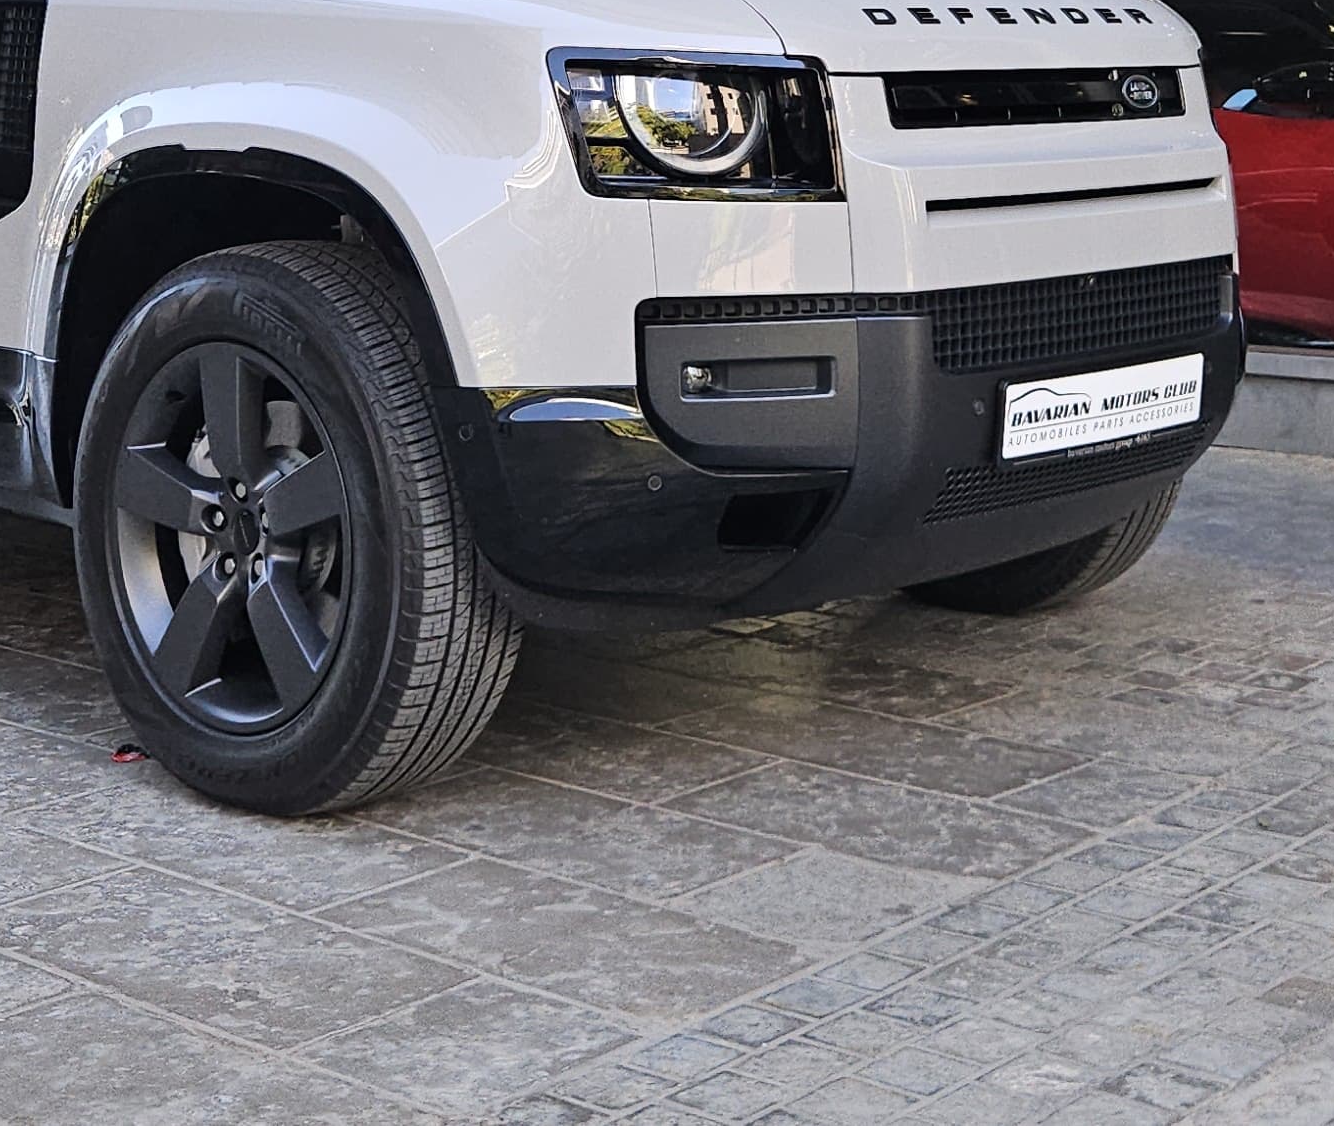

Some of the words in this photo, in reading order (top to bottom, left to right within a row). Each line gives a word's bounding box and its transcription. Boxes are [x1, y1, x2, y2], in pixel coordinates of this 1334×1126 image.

[862, 7, 1154, 26] DEFENDER
[1008, 425, 1087, 447] AUTOMOBILES
[1093, 417, 1124, 432] PARTS
[1129, 402, 1194, 424] ACCESSORIES
[1011, 400, 1092, 427] BAVARIAN
[1100, 387, 1160, 412] MOTORS
[1164, 380, 1197, 398] CLUB
